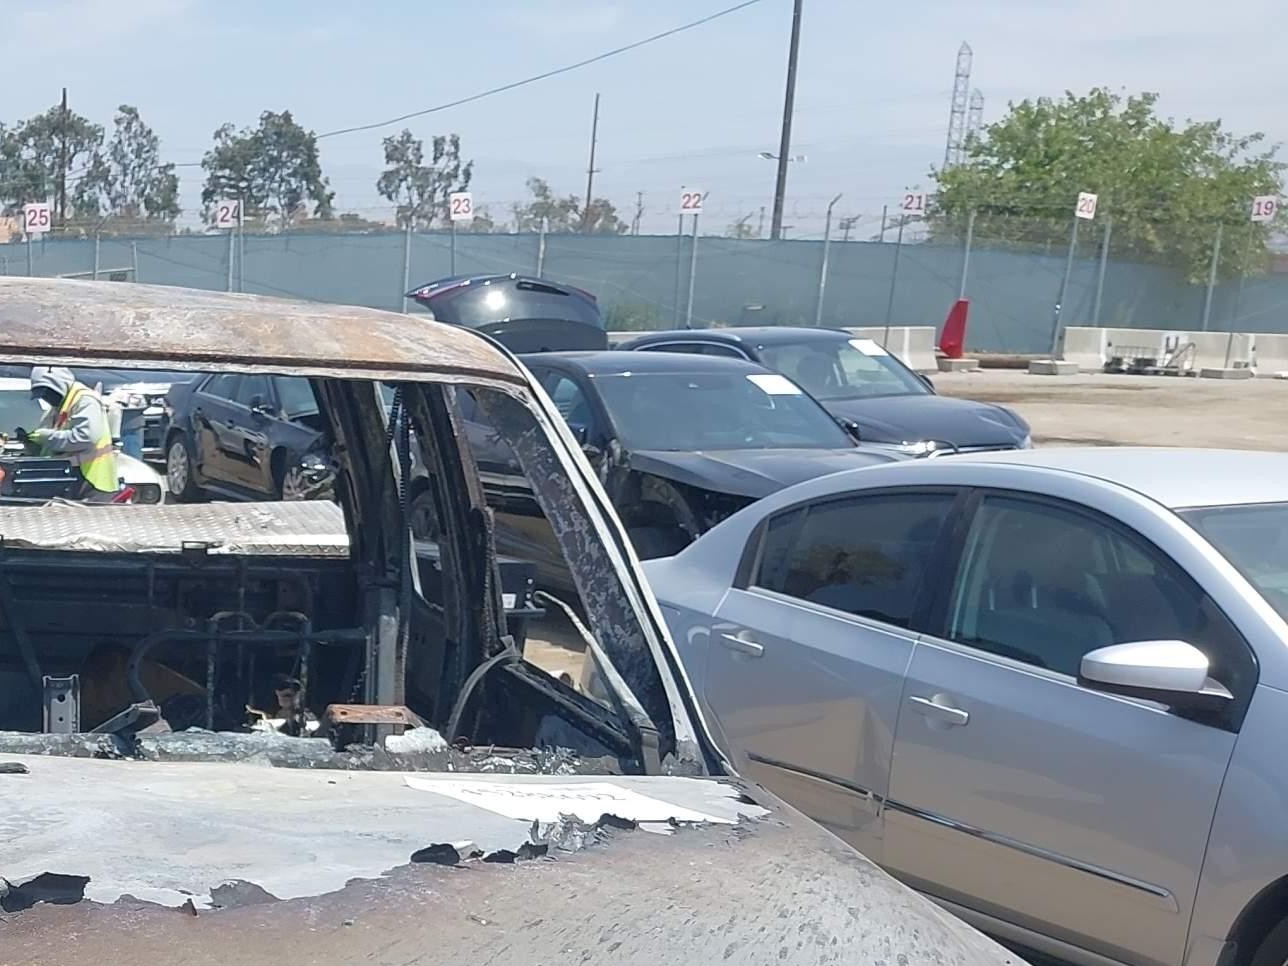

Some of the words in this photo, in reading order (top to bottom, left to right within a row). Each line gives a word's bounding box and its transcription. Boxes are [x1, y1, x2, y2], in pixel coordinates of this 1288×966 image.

[452, 198, 471, 215] 23
[682, 193, 701, 209] 22
[904, 194, 923, 210] 21
[1079, 198, 1094, 214] 20
[1254, 201, 1274, 216] 19
[28, 209, 48, 226] 25
